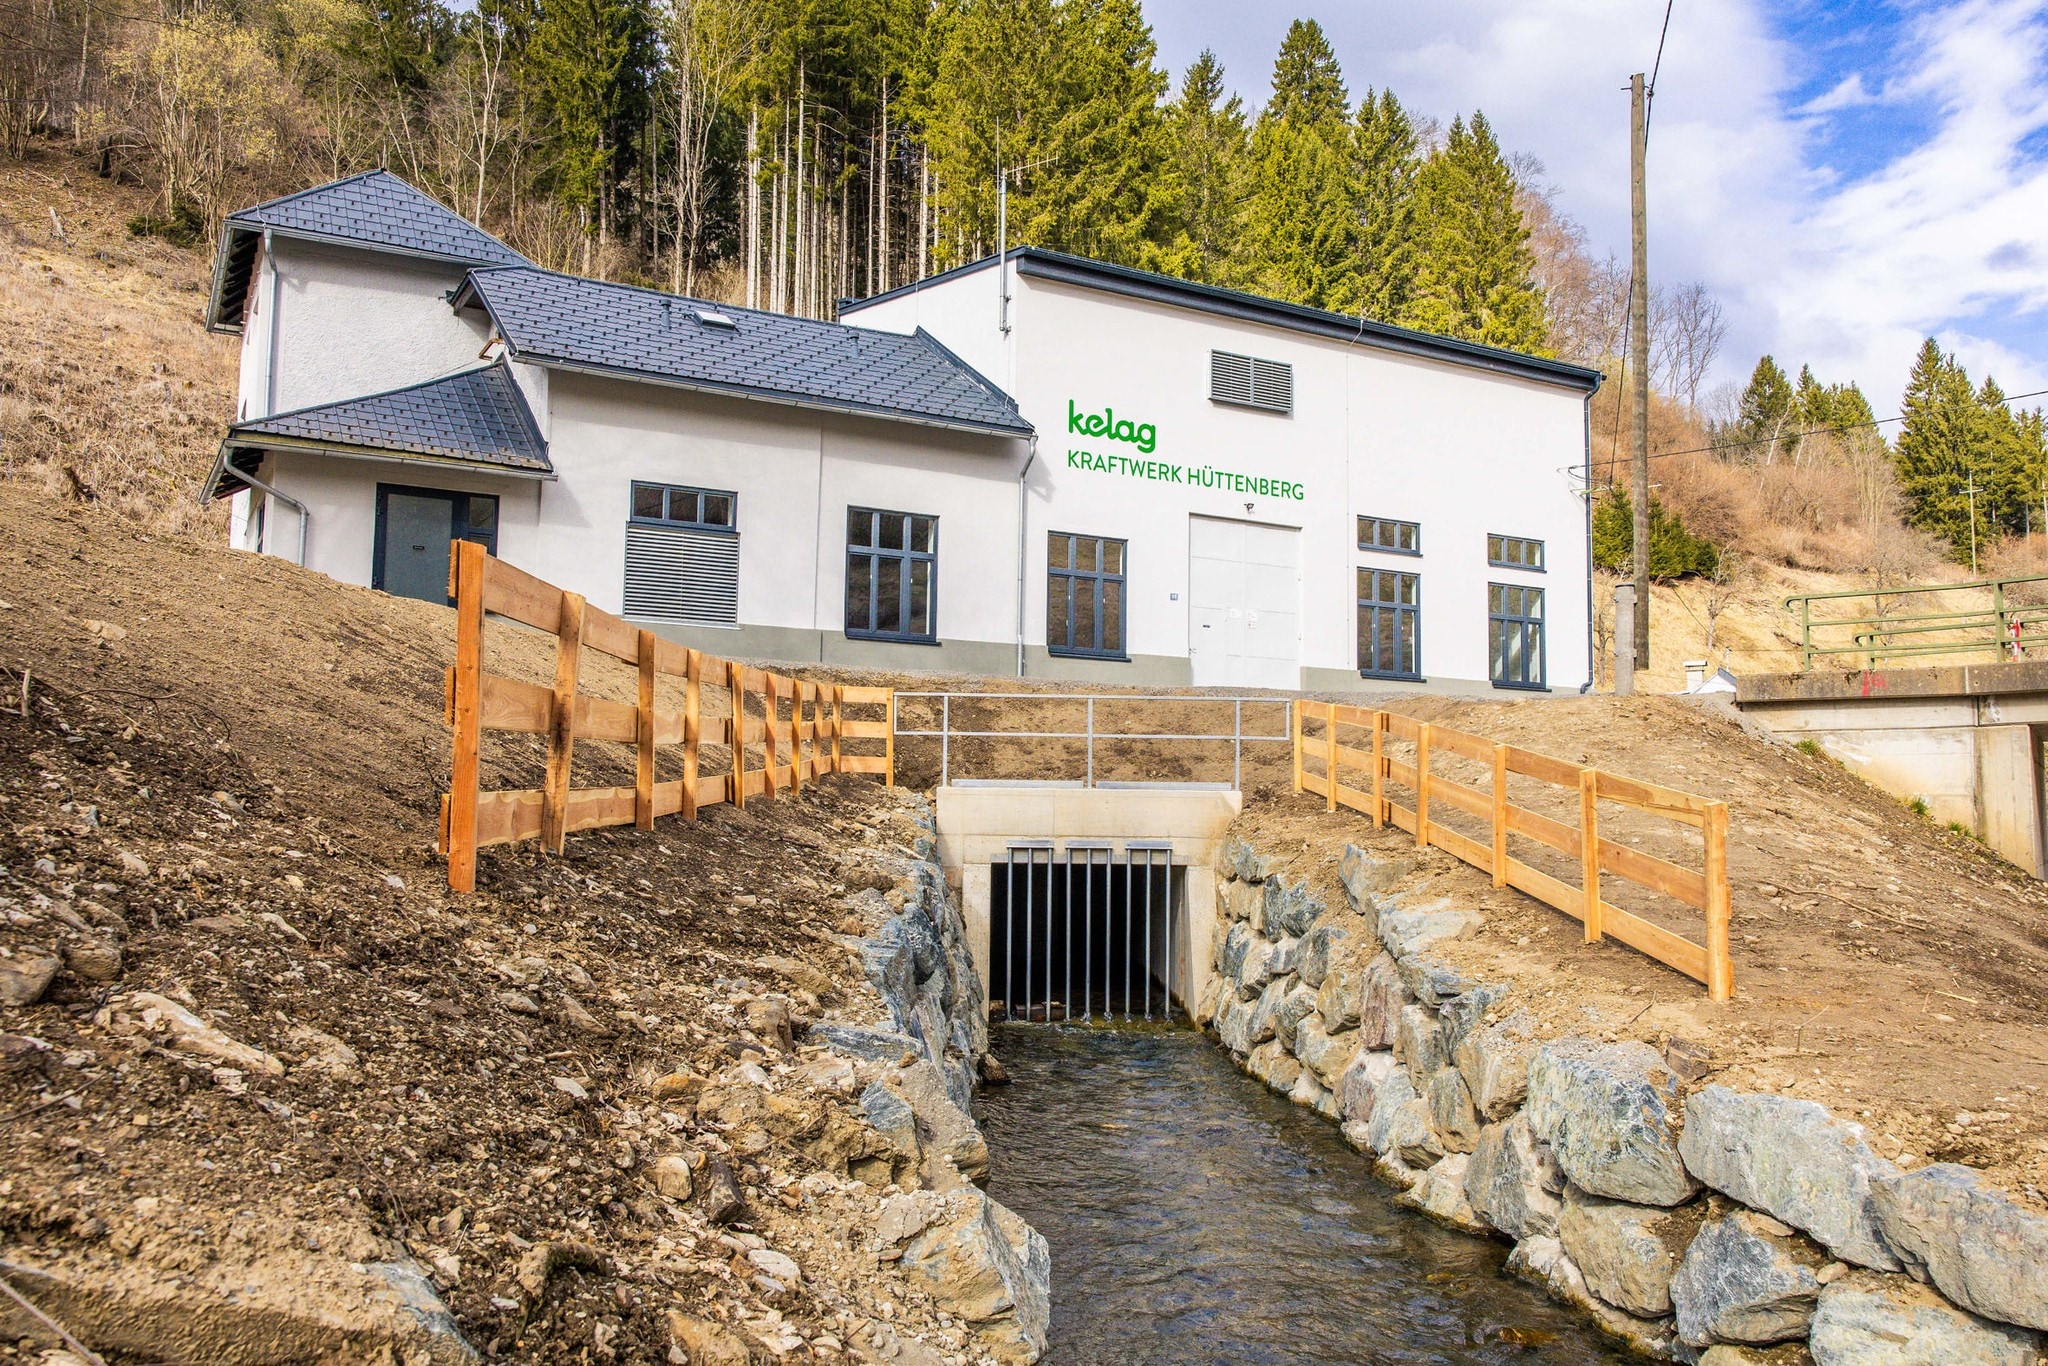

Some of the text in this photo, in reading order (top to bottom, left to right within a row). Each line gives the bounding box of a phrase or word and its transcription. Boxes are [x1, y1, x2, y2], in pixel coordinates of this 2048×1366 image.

[1068, 399, 1156, 454] kelag
[1067, 449, 1305, 501] KRAFTWERK HÜTTENBERG
